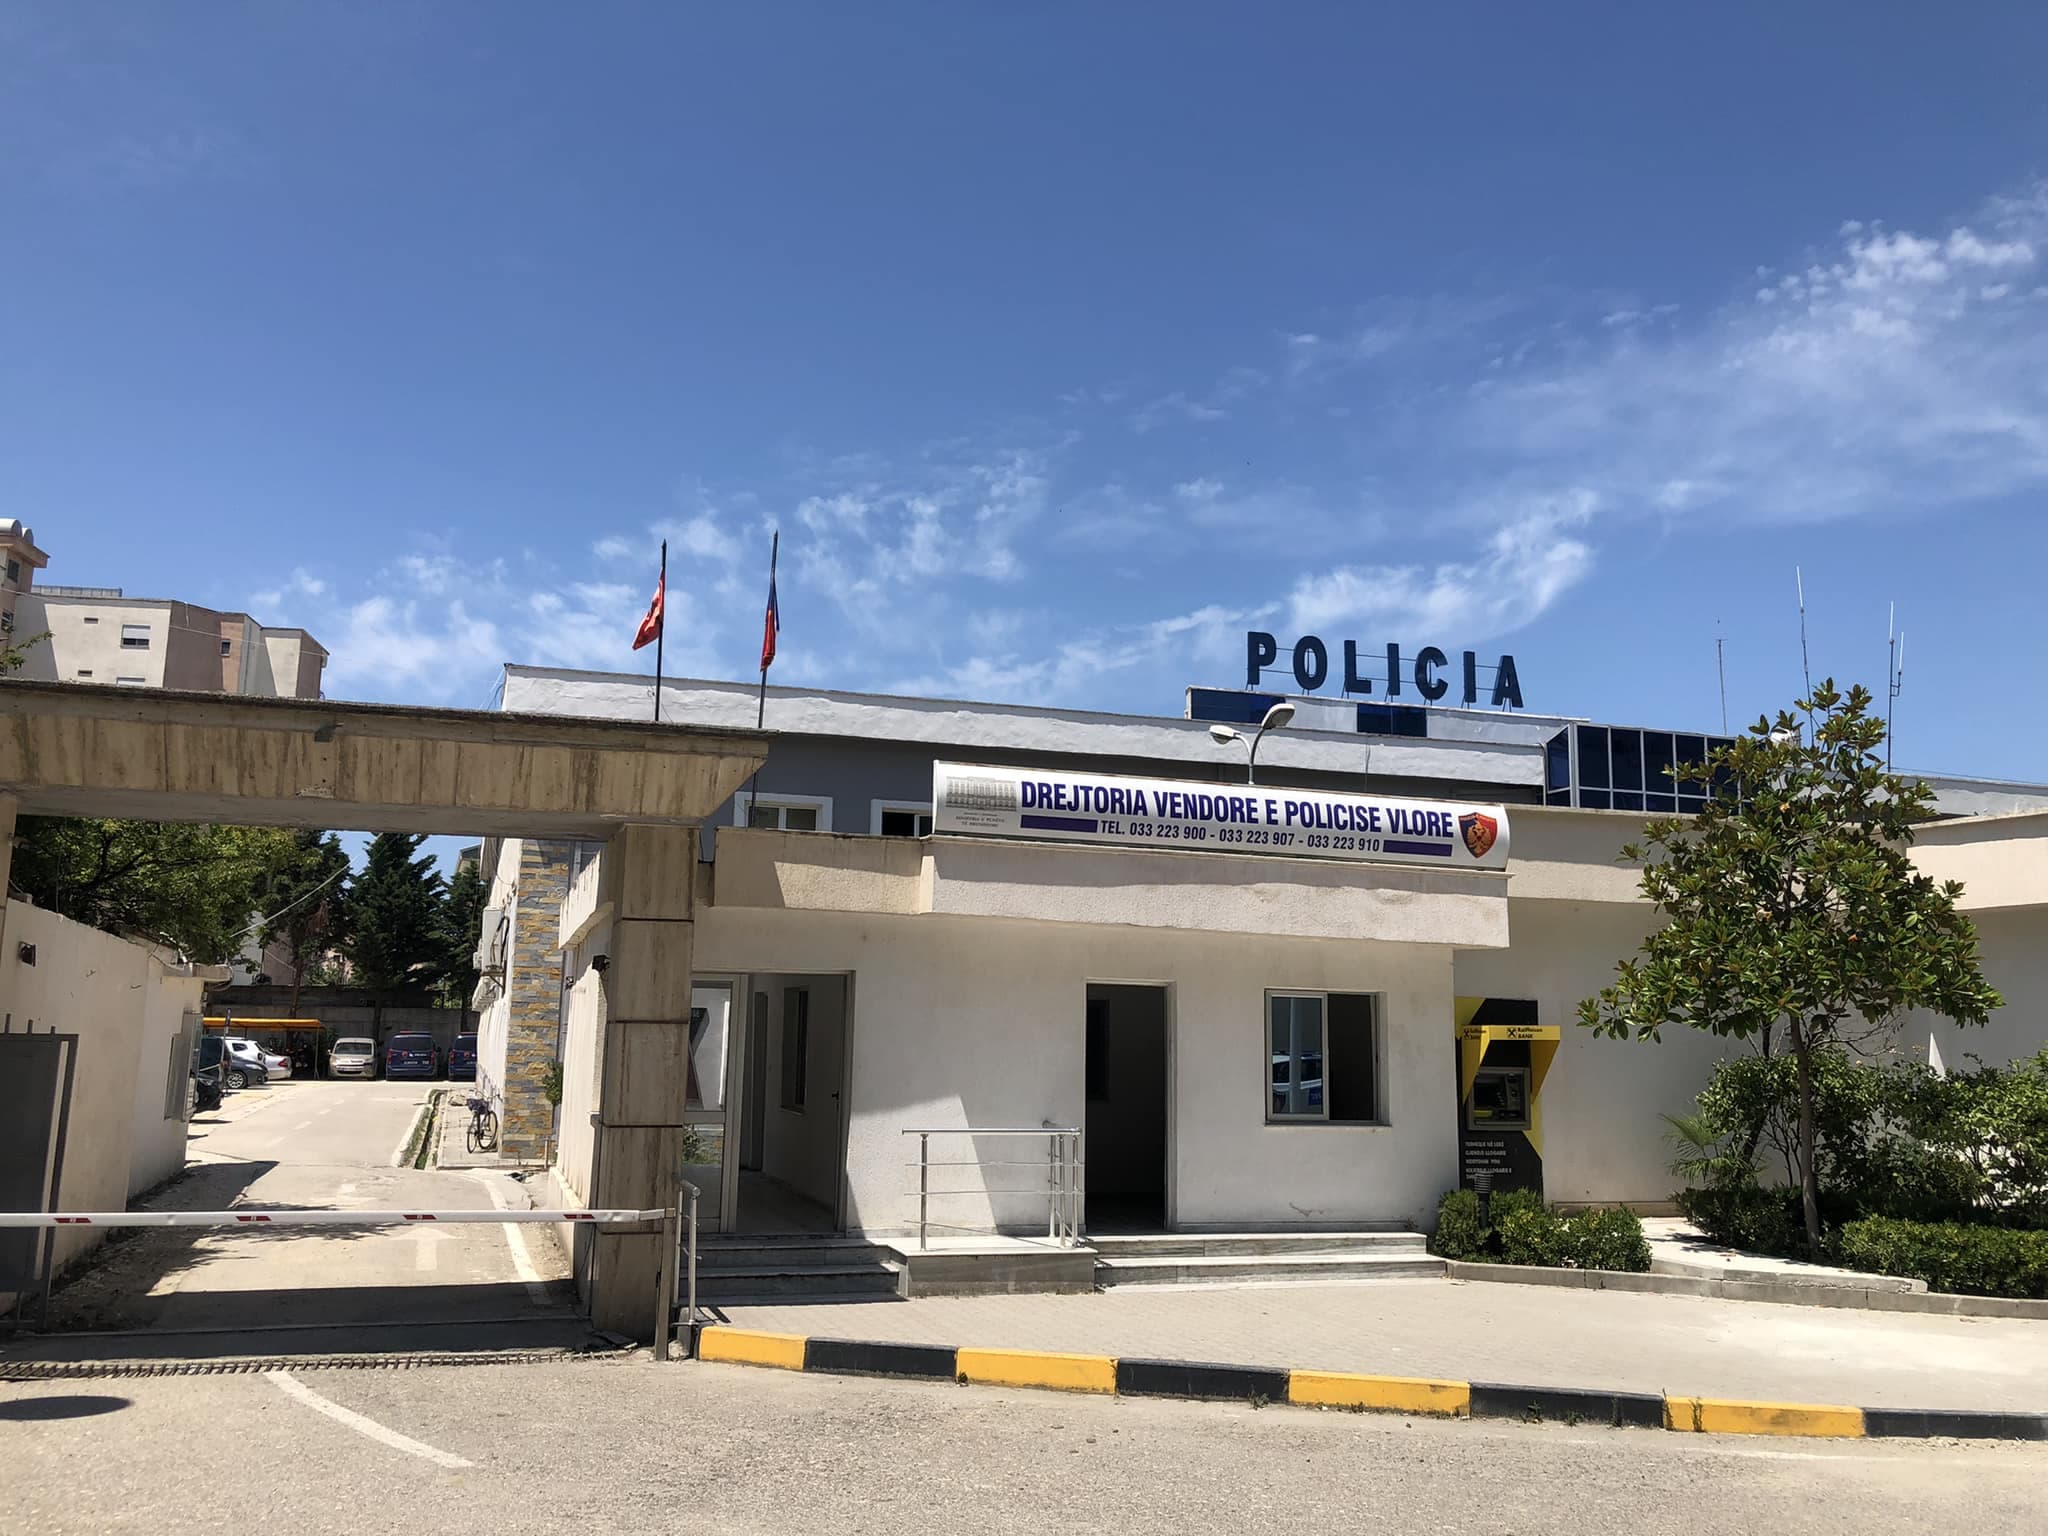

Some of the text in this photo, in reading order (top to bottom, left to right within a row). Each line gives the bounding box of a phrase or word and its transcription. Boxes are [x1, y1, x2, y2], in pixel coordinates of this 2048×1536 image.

[1247, 631, 1524, 708] POLICIA
[1021, 781, 1454, 838] DREJTORIA VENDORE E POLICISE VLORE
[1100, 820, 1125, 835] TEL.
[1130, 822, 1153, 837] 033
[1156, 824, 1180, 839] 223
[1183, 826, 1206, 841] 900
[1219, 828, 1243, 843] 033
[1246, 830, 1269, 845] 223
[1272, 832, 1295, 846] 907
[1307, 834, 1329, 849] 033
[1333, 836, 1354, 850] 223
[1358, 838, 1379, 852] 910
